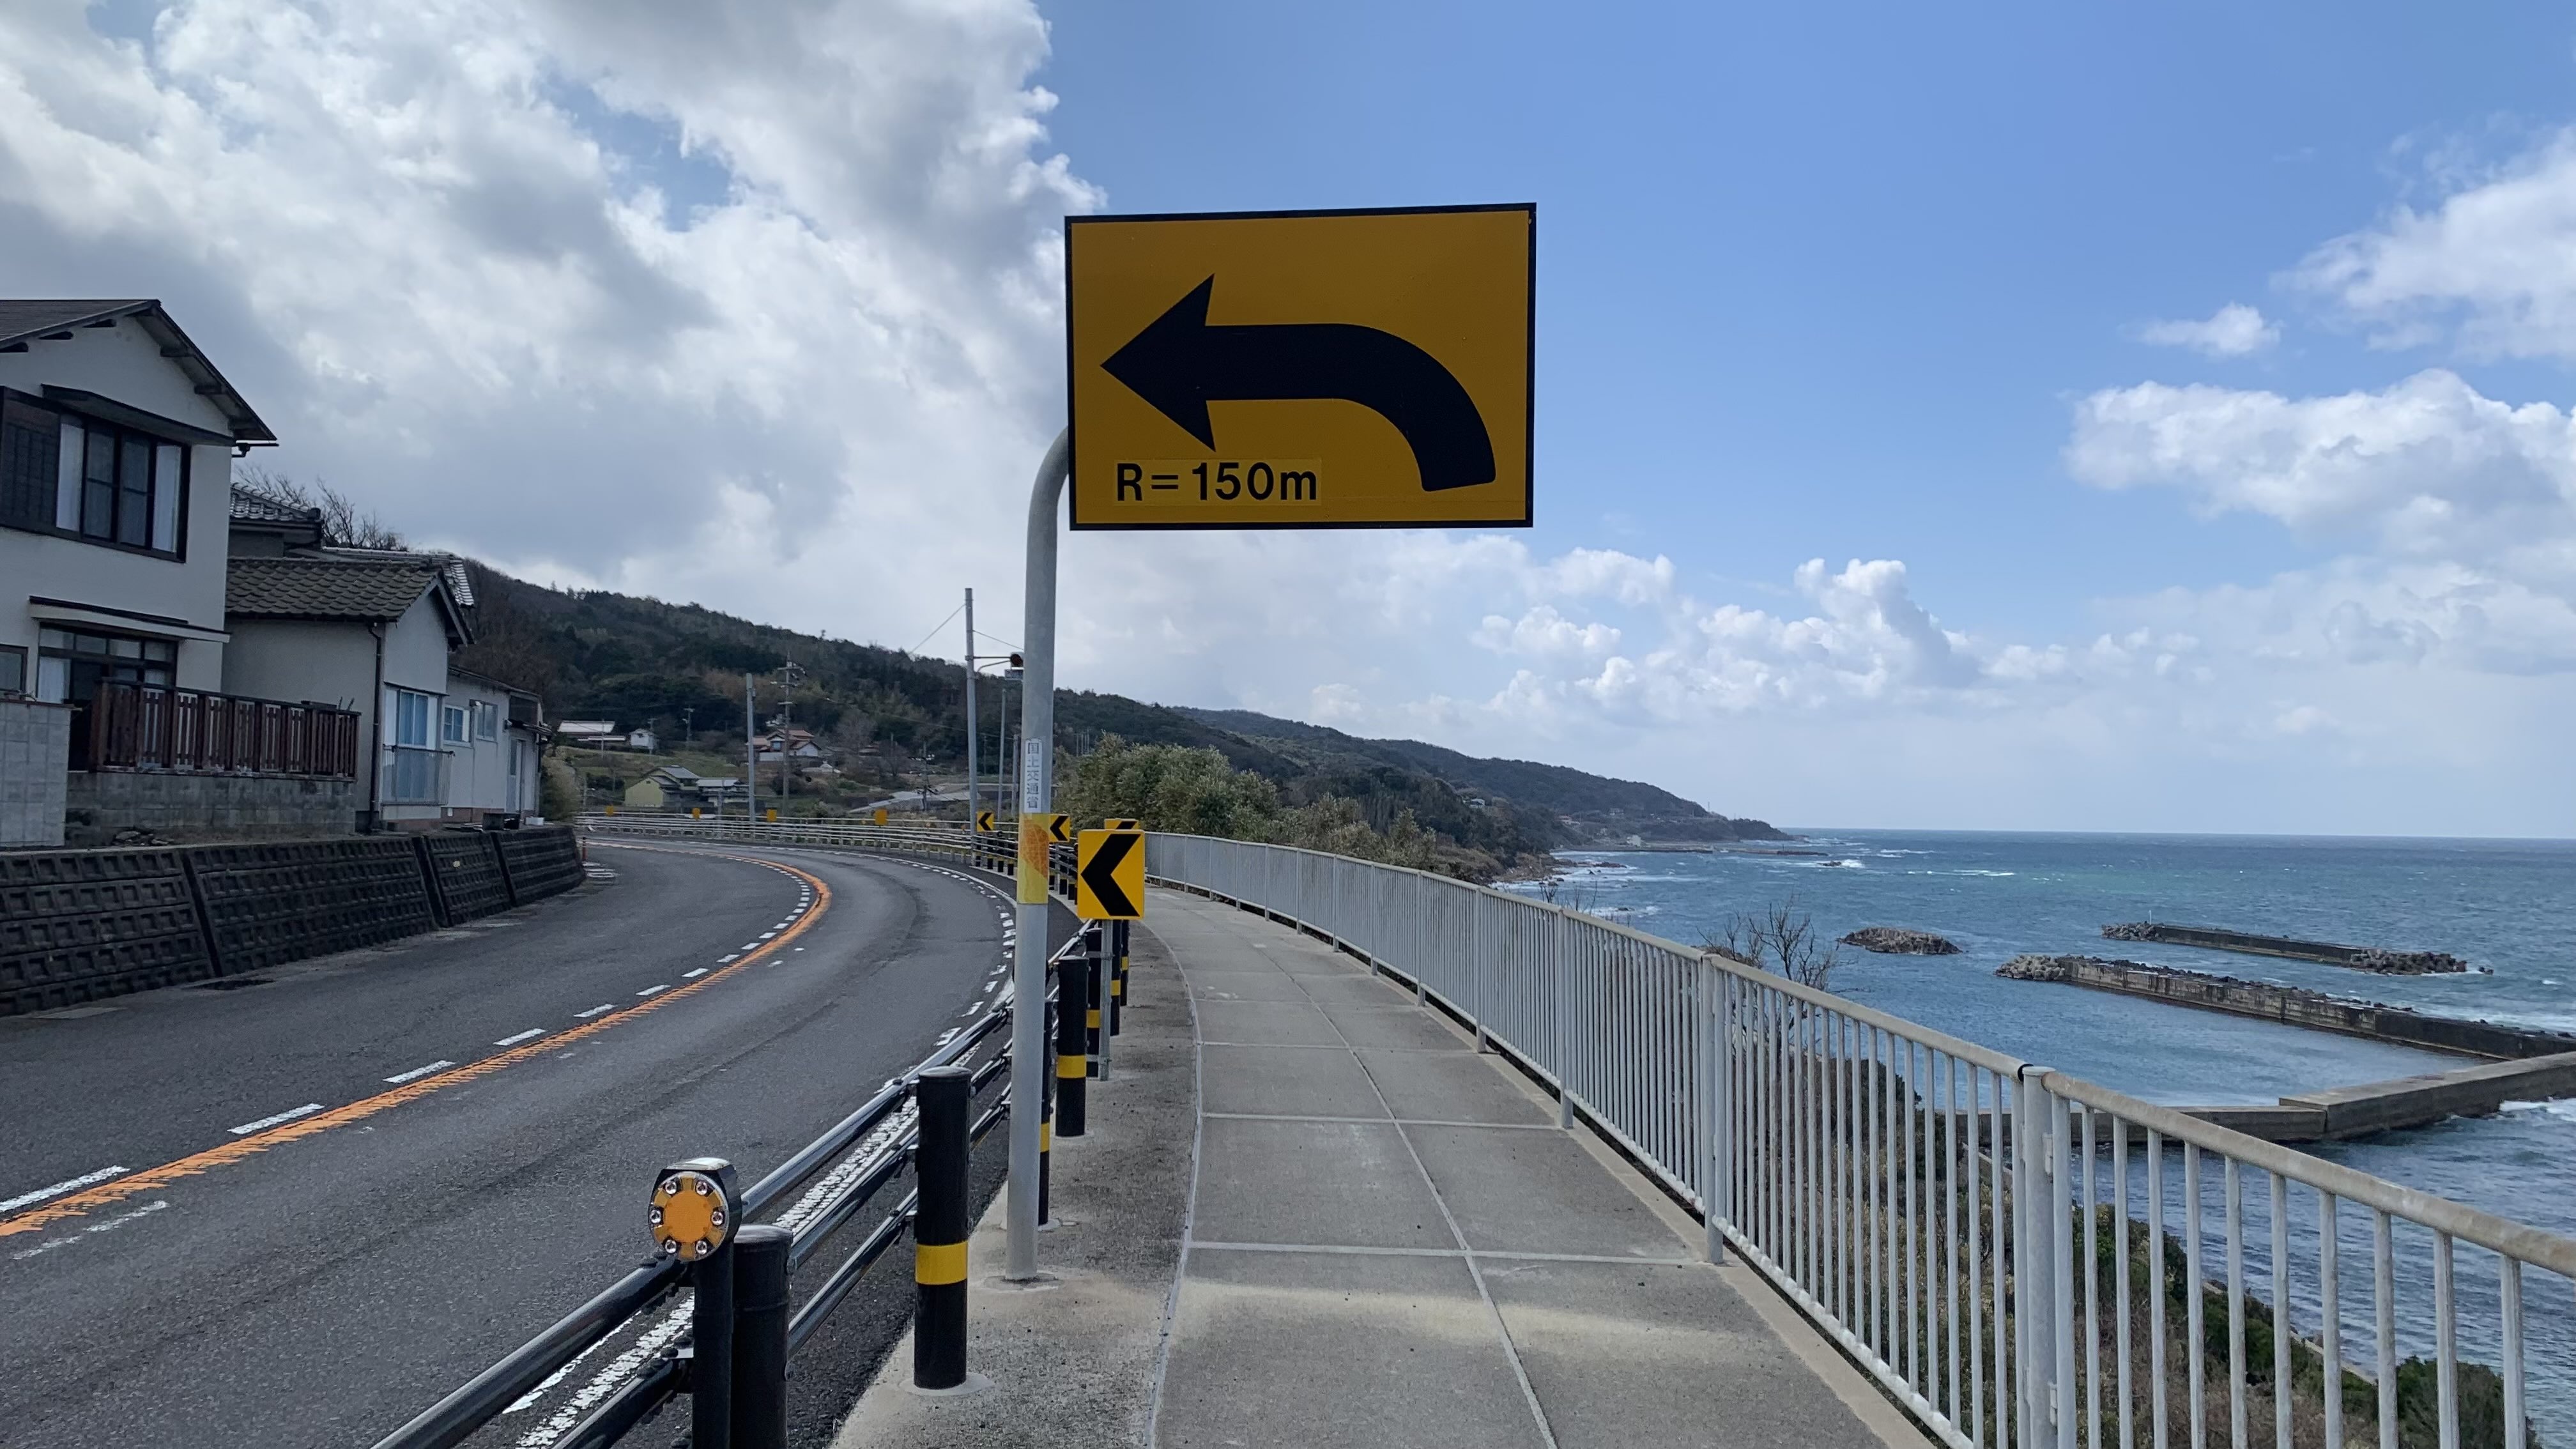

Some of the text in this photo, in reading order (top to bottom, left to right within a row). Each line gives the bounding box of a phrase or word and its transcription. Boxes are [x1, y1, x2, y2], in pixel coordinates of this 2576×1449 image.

[1027, 742, 1039, 808] 国土交通省
